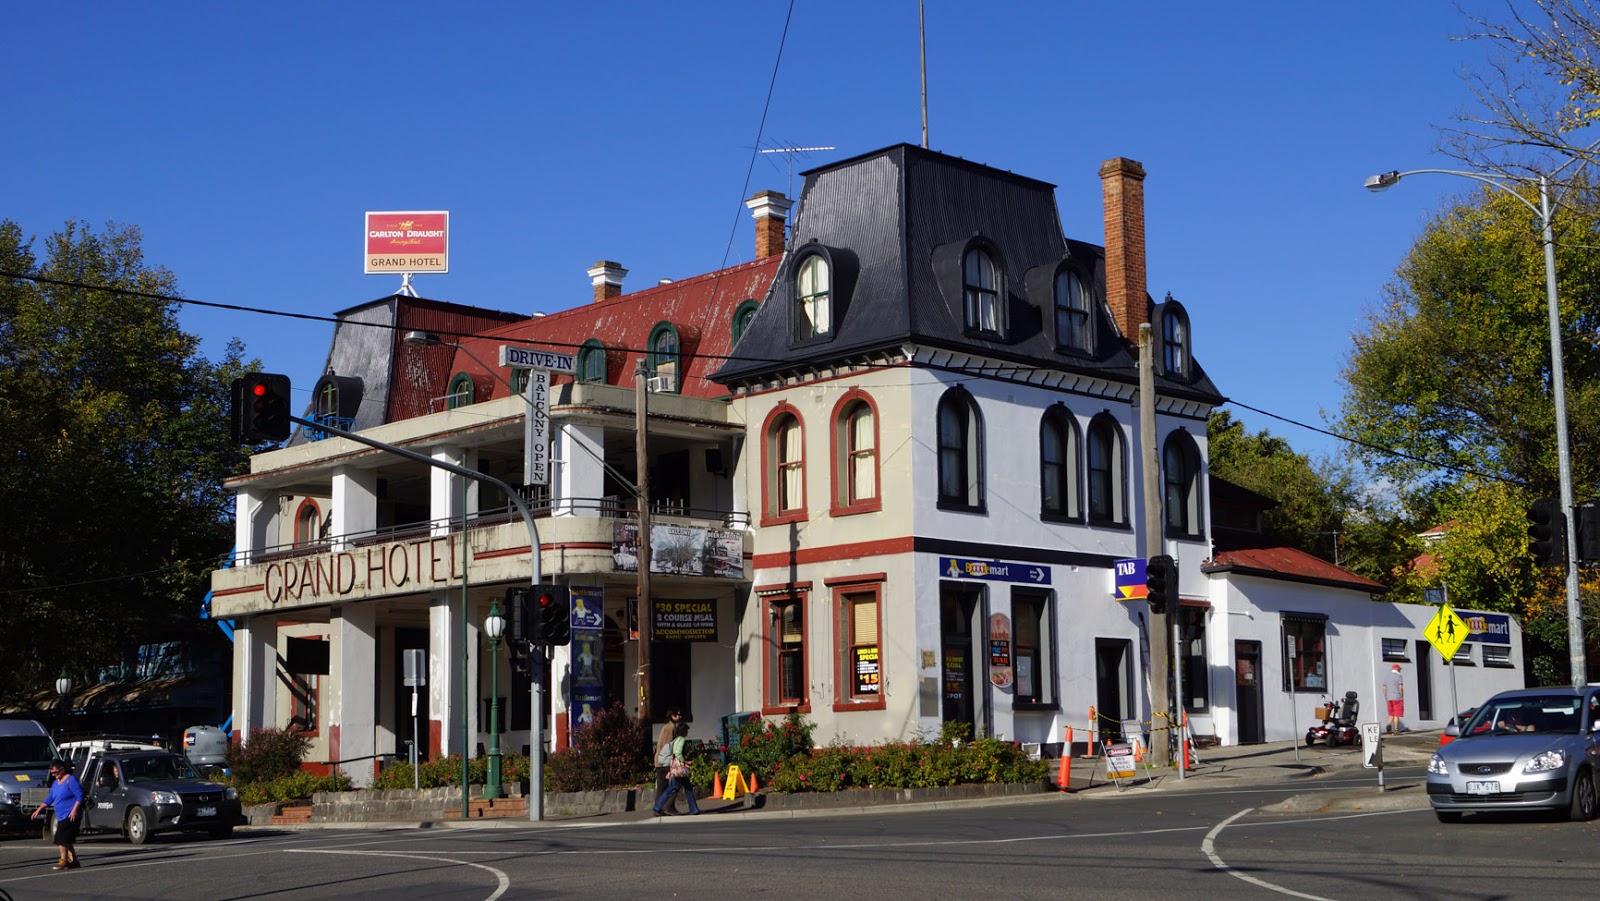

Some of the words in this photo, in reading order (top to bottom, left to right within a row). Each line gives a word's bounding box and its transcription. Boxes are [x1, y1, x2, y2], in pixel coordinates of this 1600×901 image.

[369, 230, 403, 238] CARLTON
[407, 229, 444, 238] DRAUGHT
[371, 258, 406, 267] GRAND
[409, 257, 442, 266] HOTEL
[509, 349, 573, 370] DRIVE-IN
[533, 374, 546, 437] BALCONY
[534, 444, 545, 481] OPEN
[265, 552, 356, 604] GRAND
[367, 536, 466, 589] HOTEL
[1117, 562, 1136, 576] TAB
[655, 603, 672, 612] $30
[674, 603, 712, 613] SPECIAL
[663, 614, 692, 622] COURSE
[693, 614, 714, 622] MEAL
